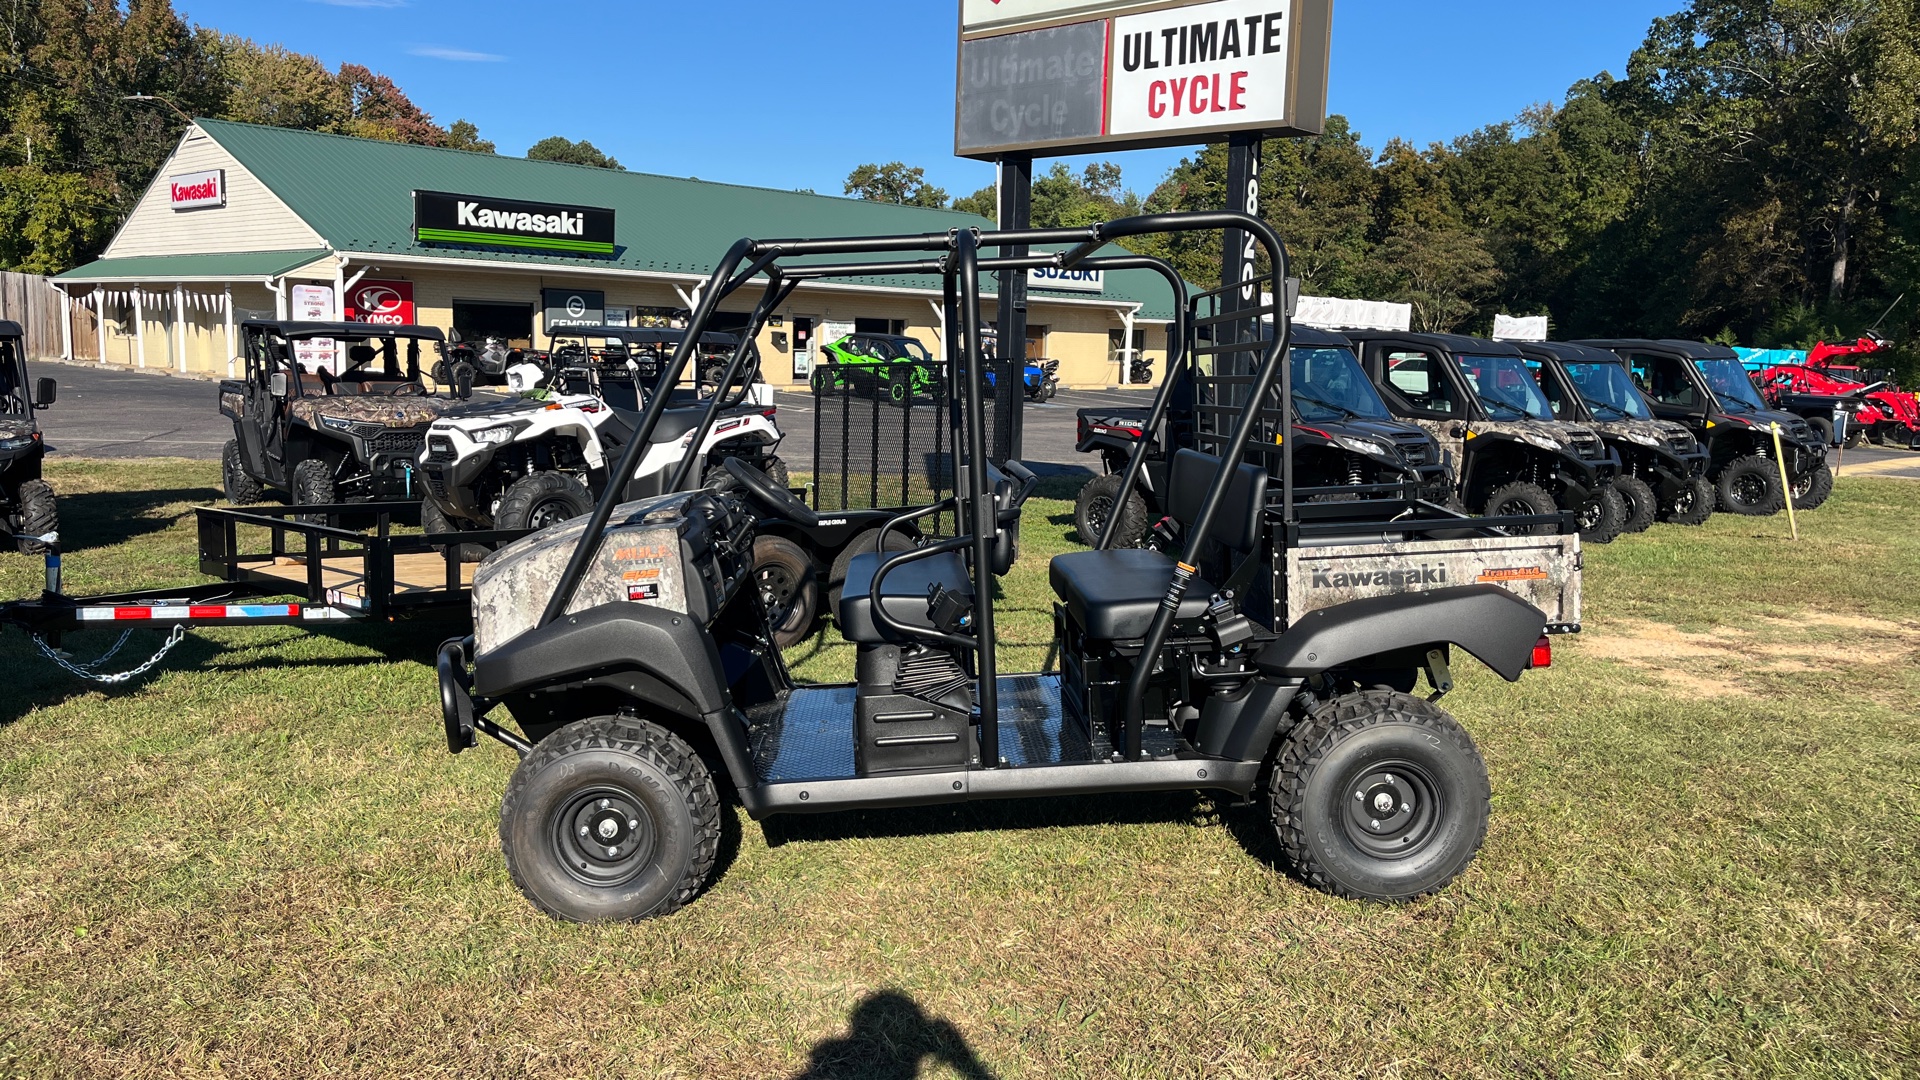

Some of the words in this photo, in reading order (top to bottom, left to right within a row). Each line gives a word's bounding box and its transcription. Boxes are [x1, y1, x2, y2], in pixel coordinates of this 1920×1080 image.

[1123, 11, 1283, 73] ULTIMATE
[970, 46, 1095, 89] Ultimate
[1148, 71, 1248, 119] CYCLE
[990, 94, 1069, 137] Cycle
[171, 177, 217, 202] Kawasaki
[457, 201, 584, 236] Kawasaki
[355, 314, 403, 325] KYMCO
[611, 544, 673, 563] MULE
[1311, 562, 1446, 588] Kawasaki
[1482, 565, 1540, 578] Trans4x4
